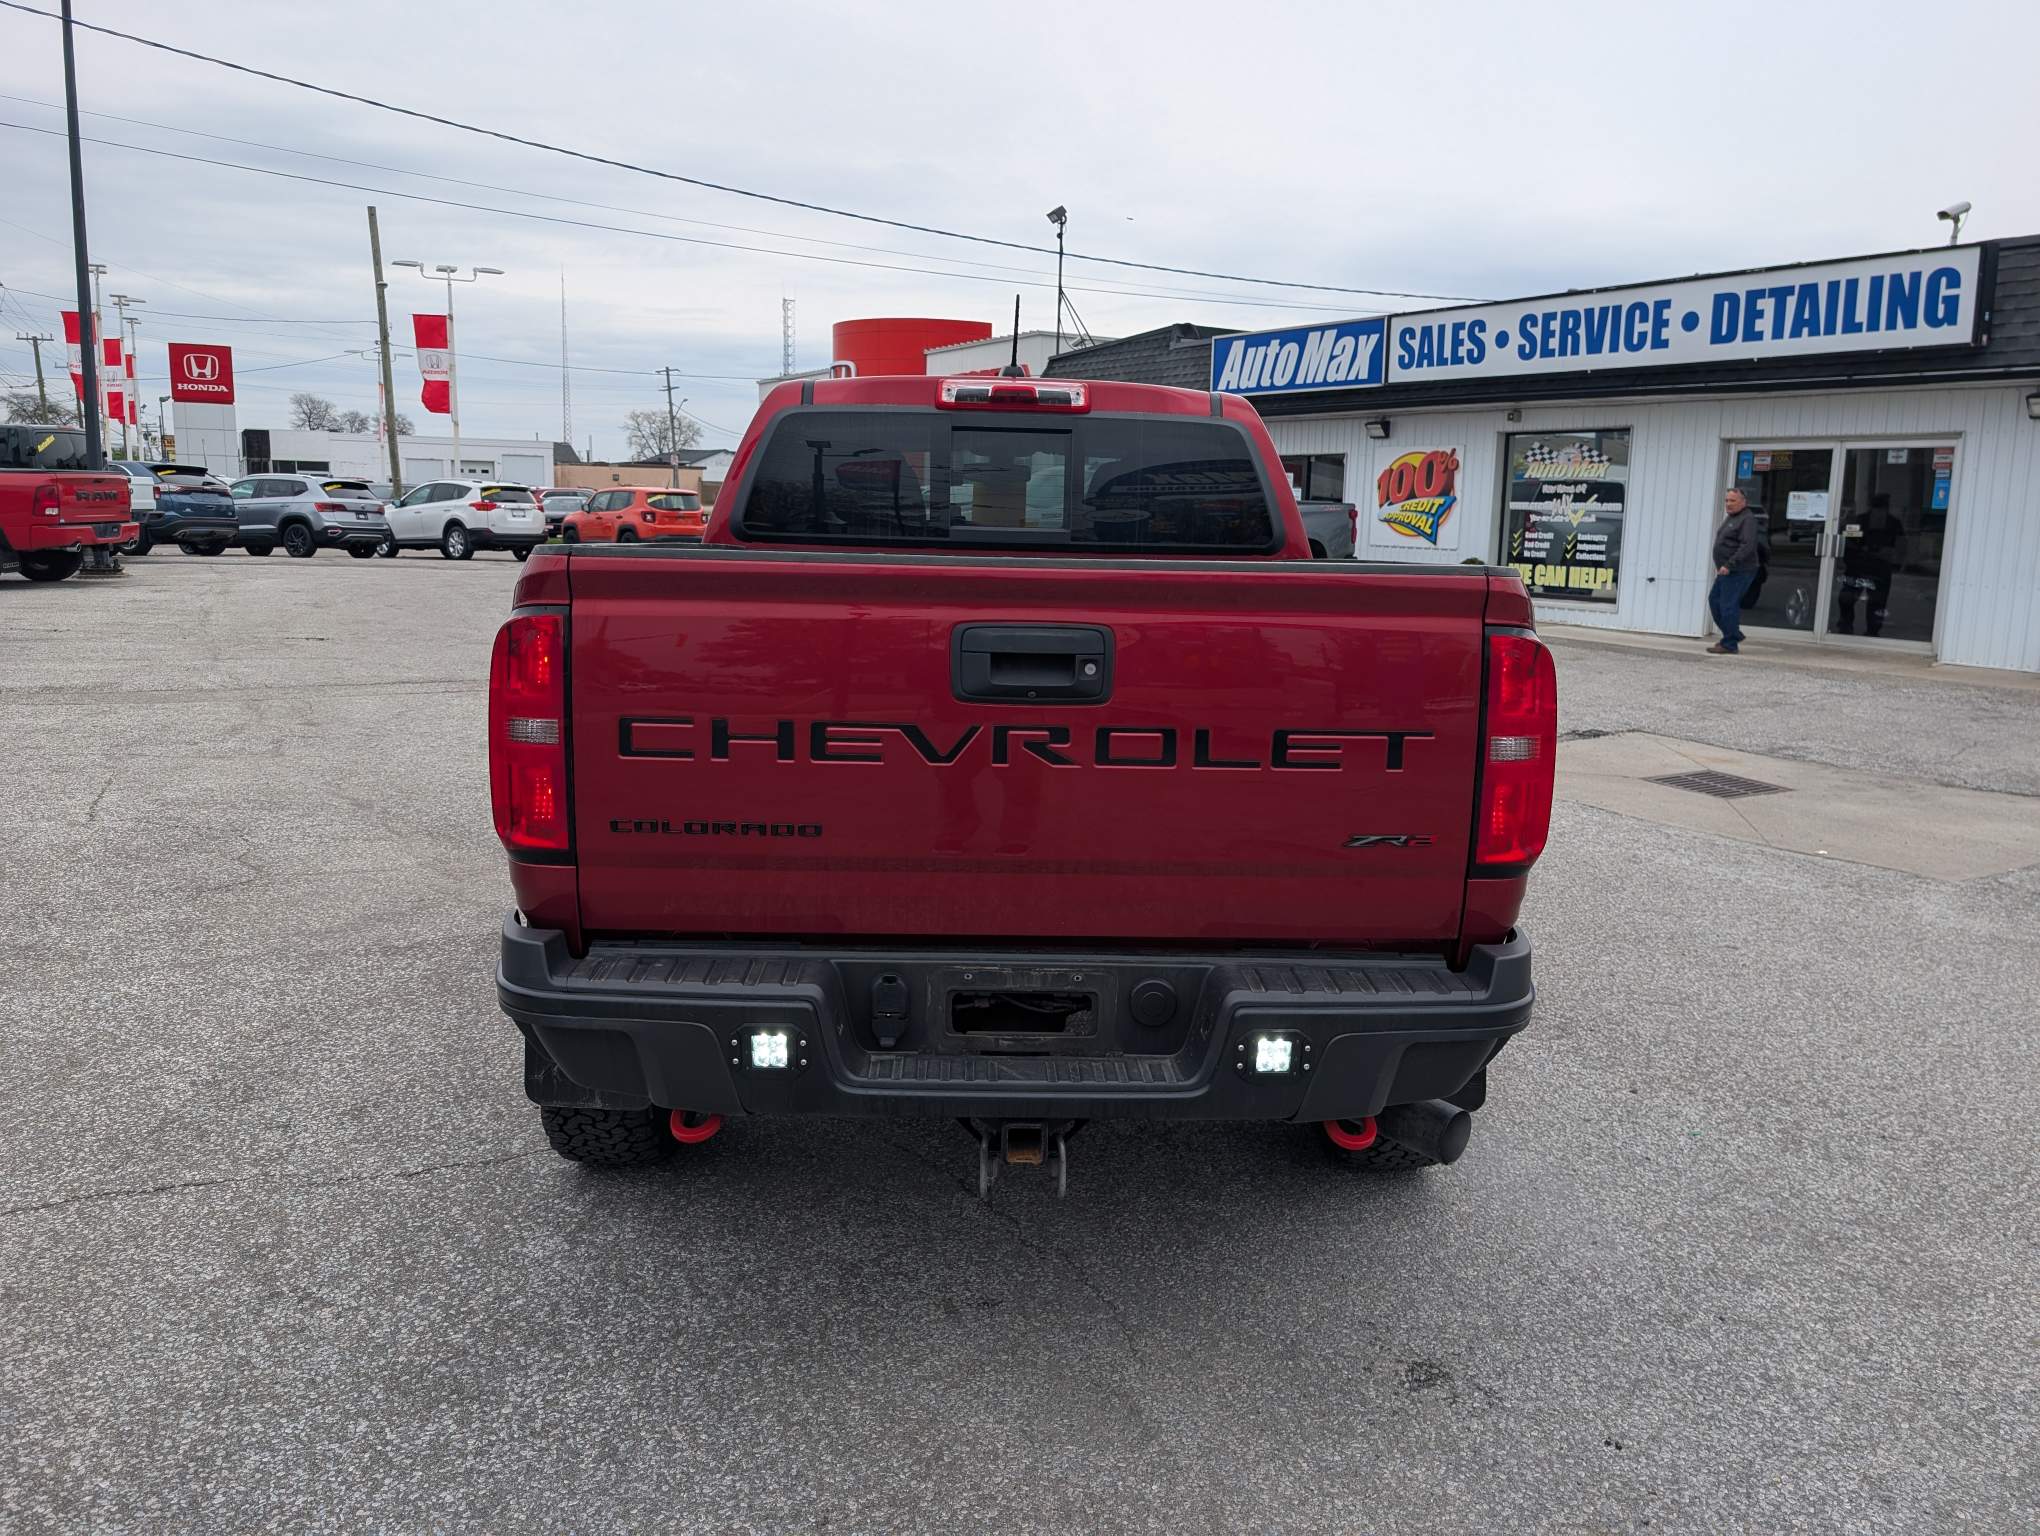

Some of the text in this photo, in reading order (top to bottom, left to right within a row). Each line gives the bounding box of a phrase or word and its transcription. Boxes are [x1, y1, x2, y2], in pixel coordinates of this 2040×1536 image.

[1398, 267, 1962, 370] SALES SERVICE DETAILING
[177, 383, 229, 392] HONDA
[1377, 448, 1459, 509] 100%
[76, 490, 118, 501] RAM
[1383, 511, 1434, 535] APPROVAL
[1524, 541, 1550, 549] Bad Credit
[1525, 531, 1554, 540] Good Credit
[1531, 550, 1547, 558] Credit
[1534, 564, 1567, 587] CAN
[1568, 566, 1614, 590] HELP!
[618, 716, 1436, 772] CHEVROLET
[609, 819, 823, 838] COLORADO
